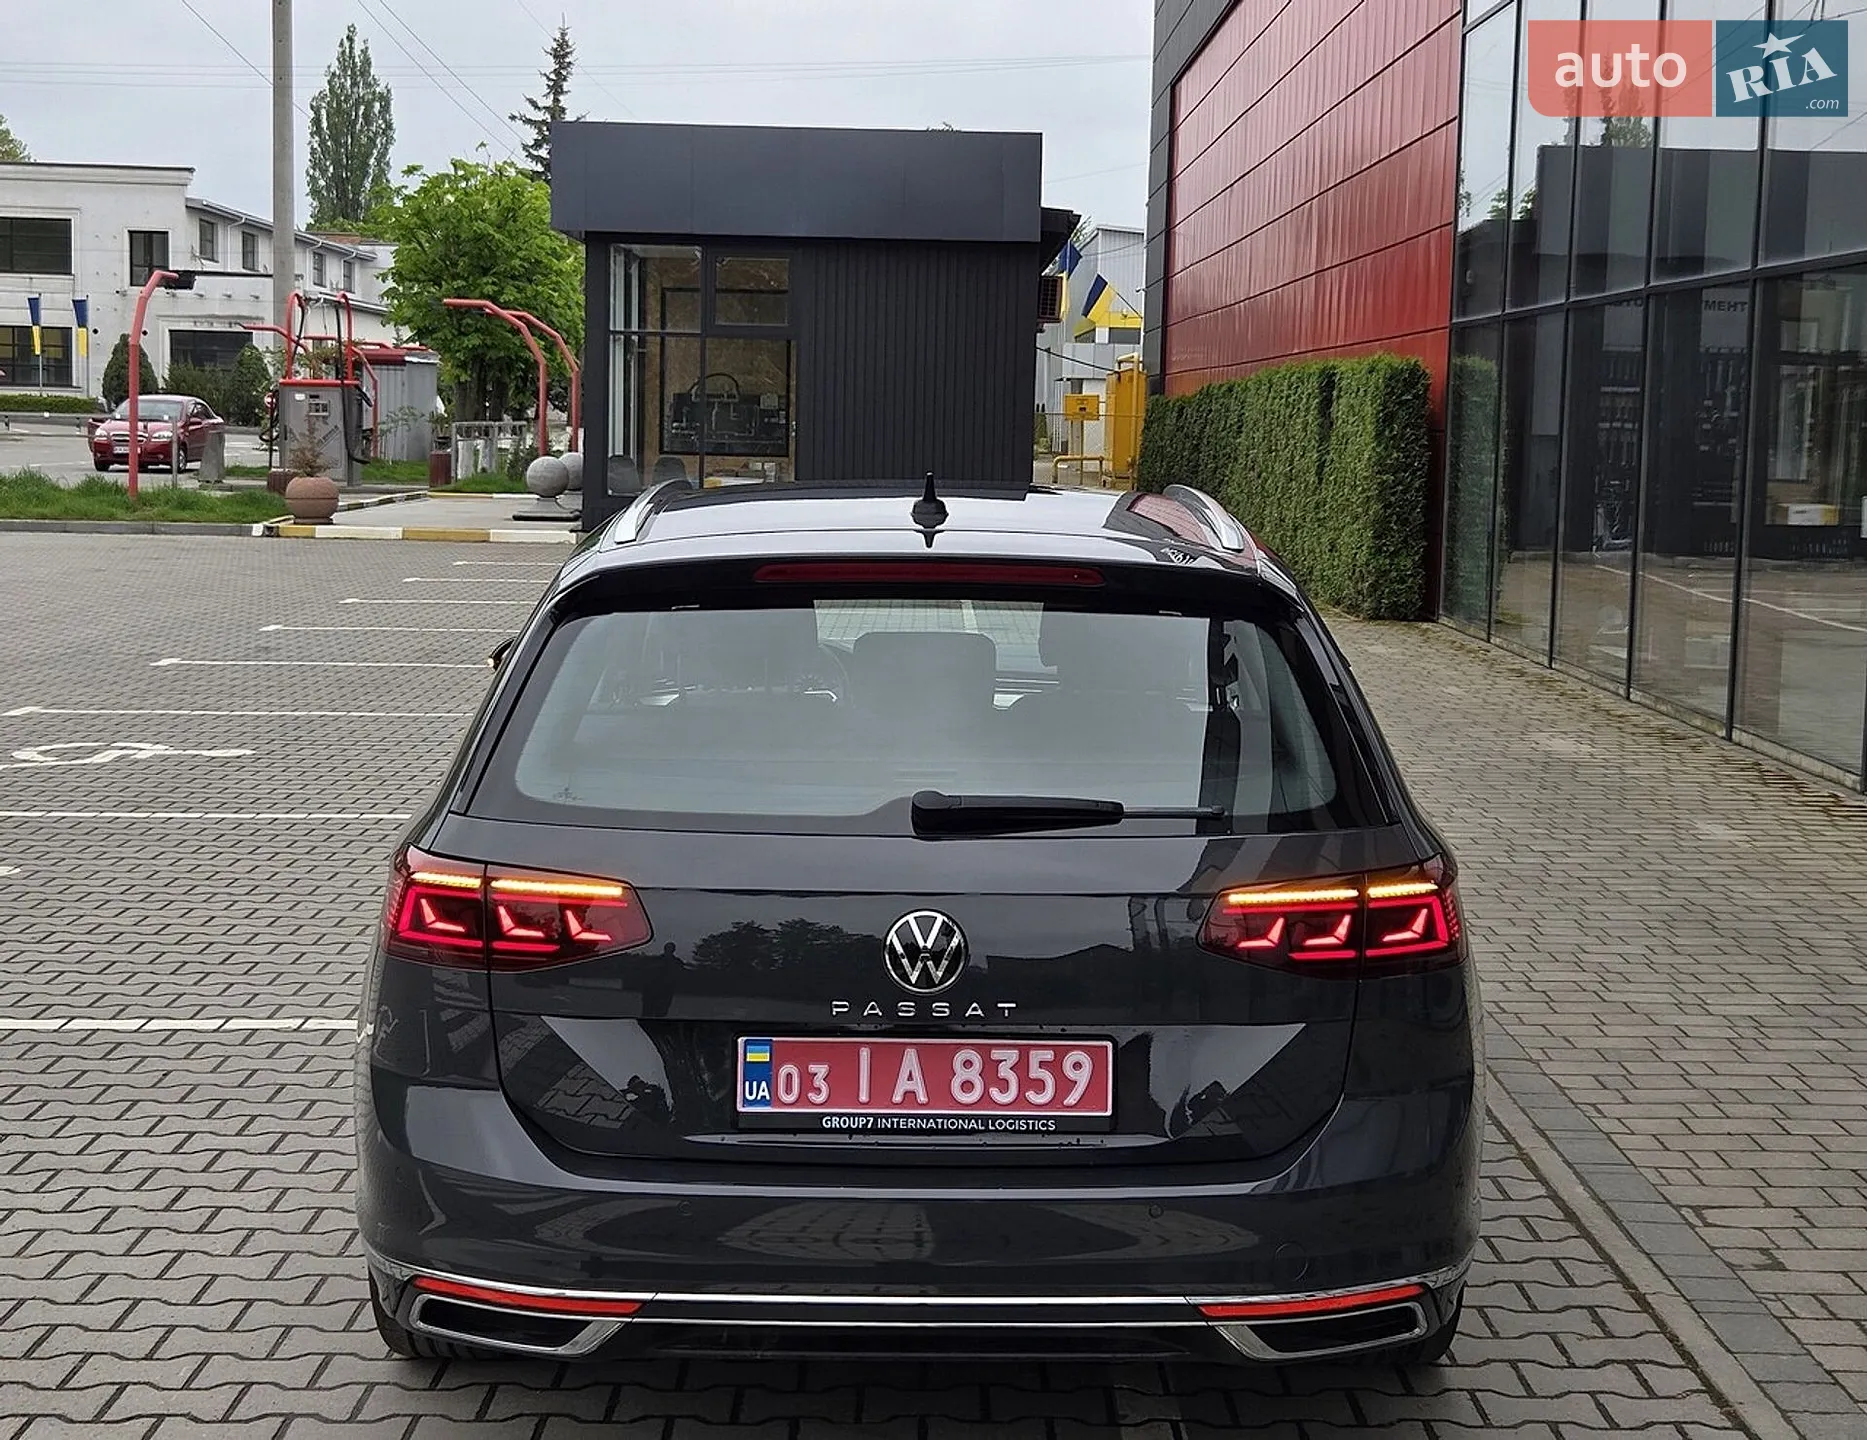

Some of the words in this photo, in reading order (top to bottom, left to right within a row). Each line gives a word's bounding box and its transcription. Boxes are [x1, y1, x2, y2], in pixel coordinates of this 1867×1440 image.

[831, 1001, 1017, 1018] PASSAT
[777, 1064, 830, 1105] 03
[950, 1048, 1094, 1107] 8359
[745, 1080, 771, 1101] UA
[822, 1115, 874, 1129] GROUP7
[877, 1117, 985, 1130] INTERNATIONAL
[988, 1119, 1056, 1131] LOGISTICS
